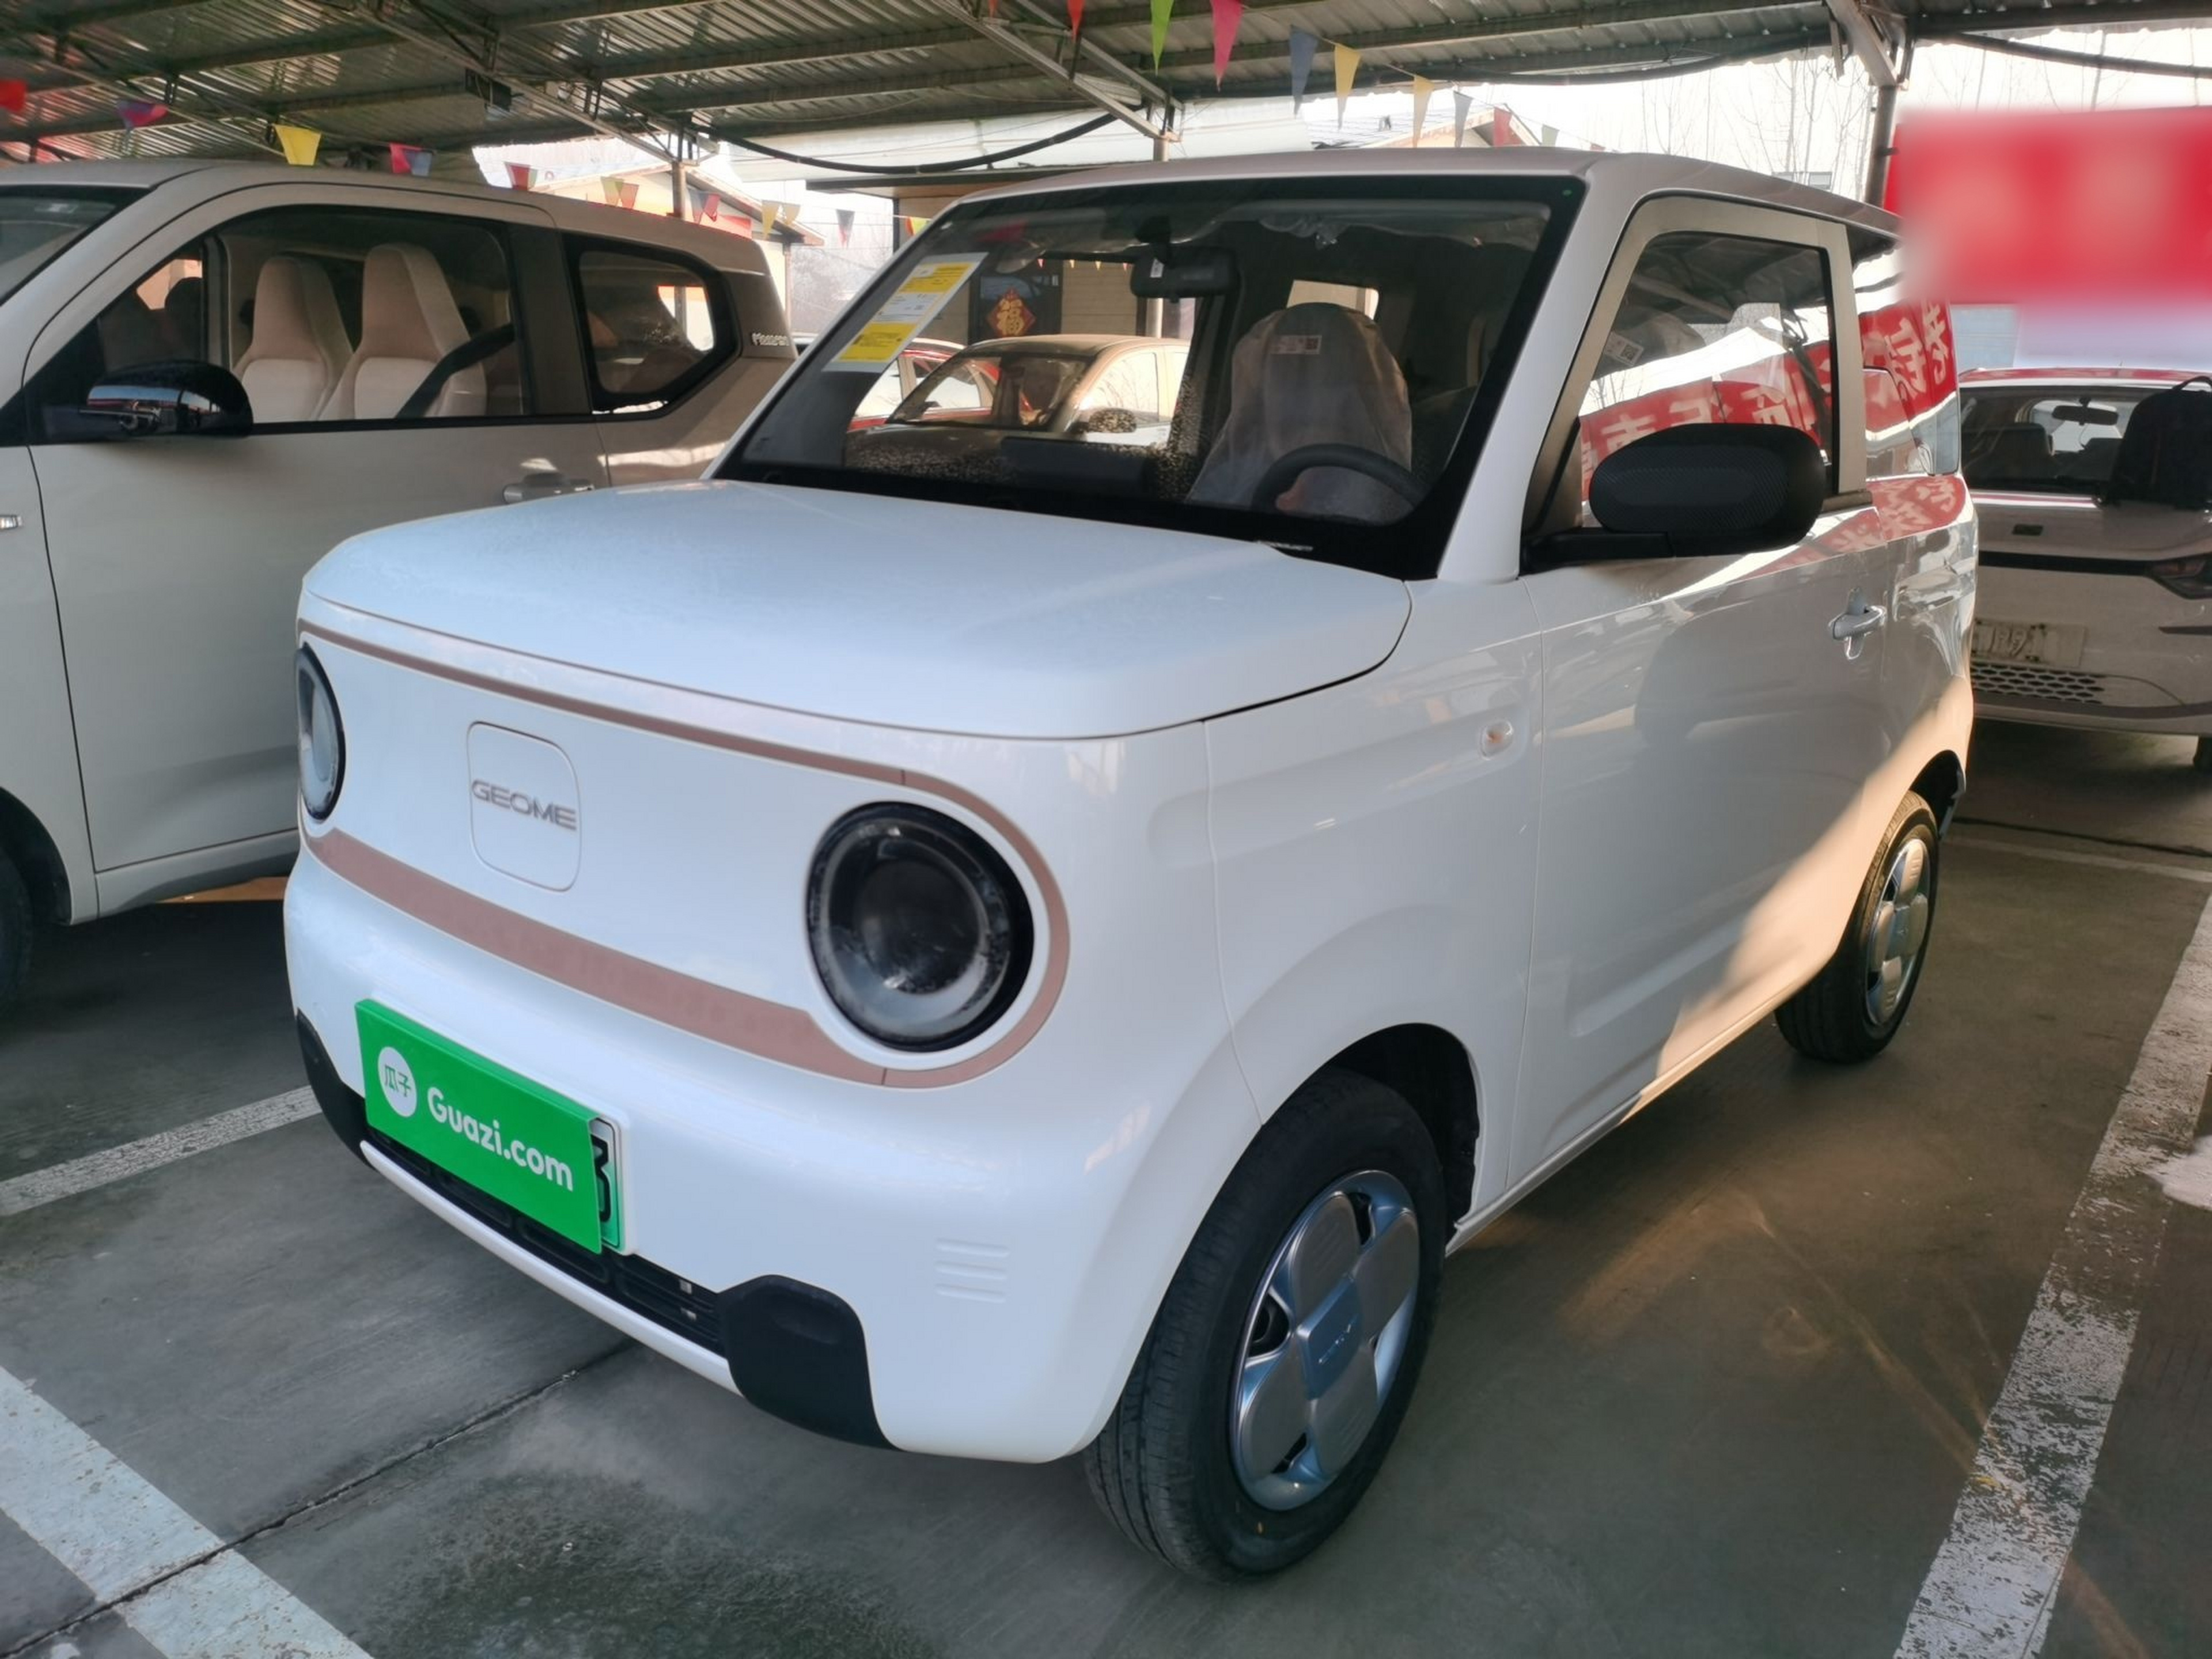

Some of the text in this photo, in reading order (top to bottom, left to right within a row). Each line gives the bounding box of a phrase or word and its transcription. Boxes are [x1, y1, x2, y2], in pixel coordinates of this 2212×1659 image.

[471, 779, 577, 831] GEOME
[384, 1065, 411, 1097] 瓜子
[427, 1086, 573, 1192] Guazi.com
